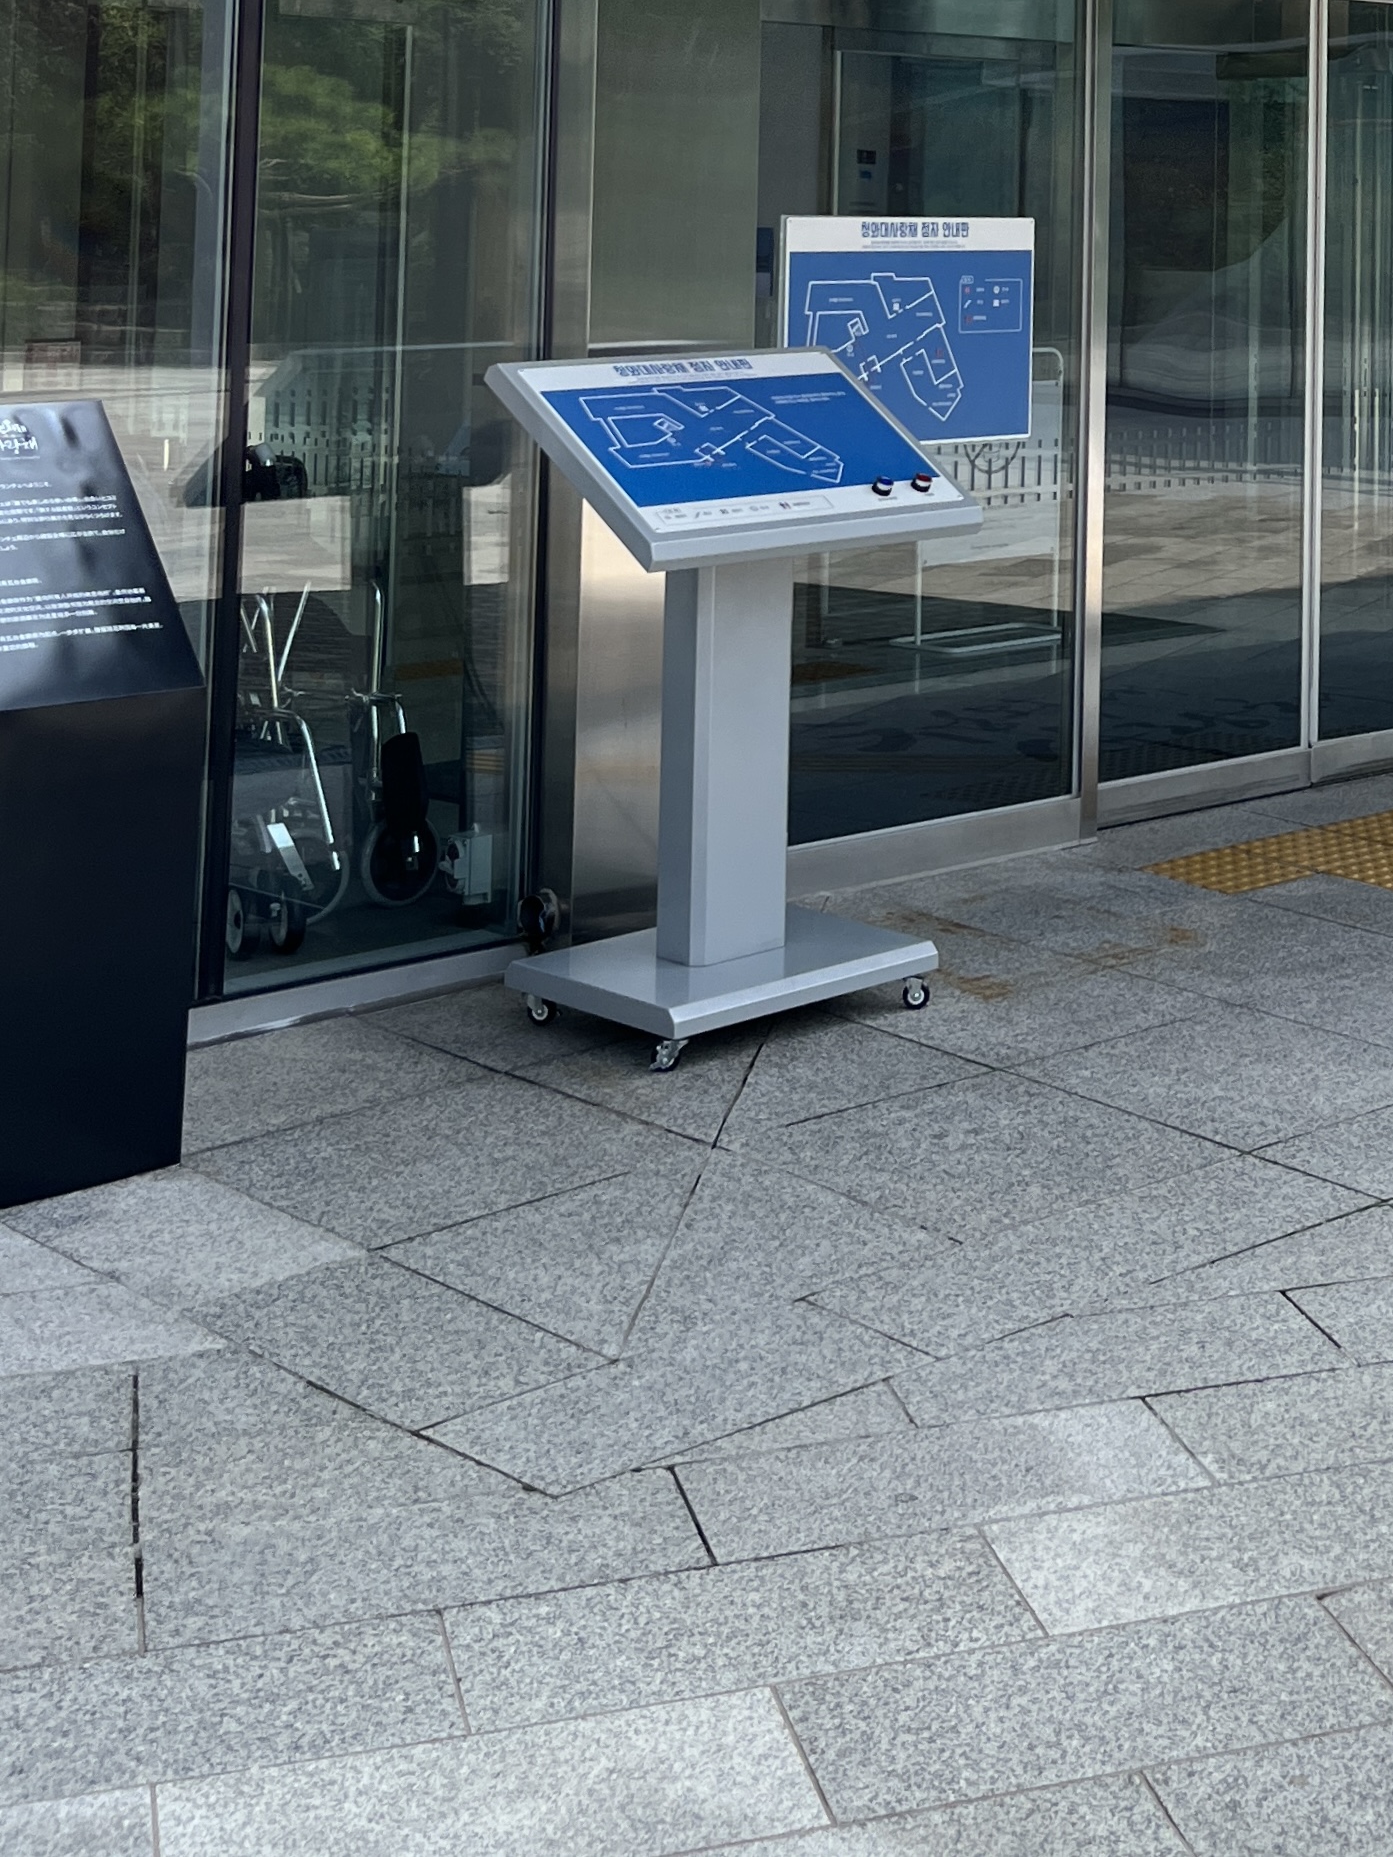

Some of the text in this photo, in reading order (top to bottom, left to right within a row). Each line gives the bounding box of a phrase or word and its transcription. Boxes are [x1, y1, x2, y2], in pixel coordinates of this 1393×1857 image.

[861, 221, 969, 238] 청와대사랑채 점자 안내판
[613, 361, 690, 378] 청와대사랑채
[687, 360, 715, 373] 점자
[714, 357, 753, 372] 안내판
